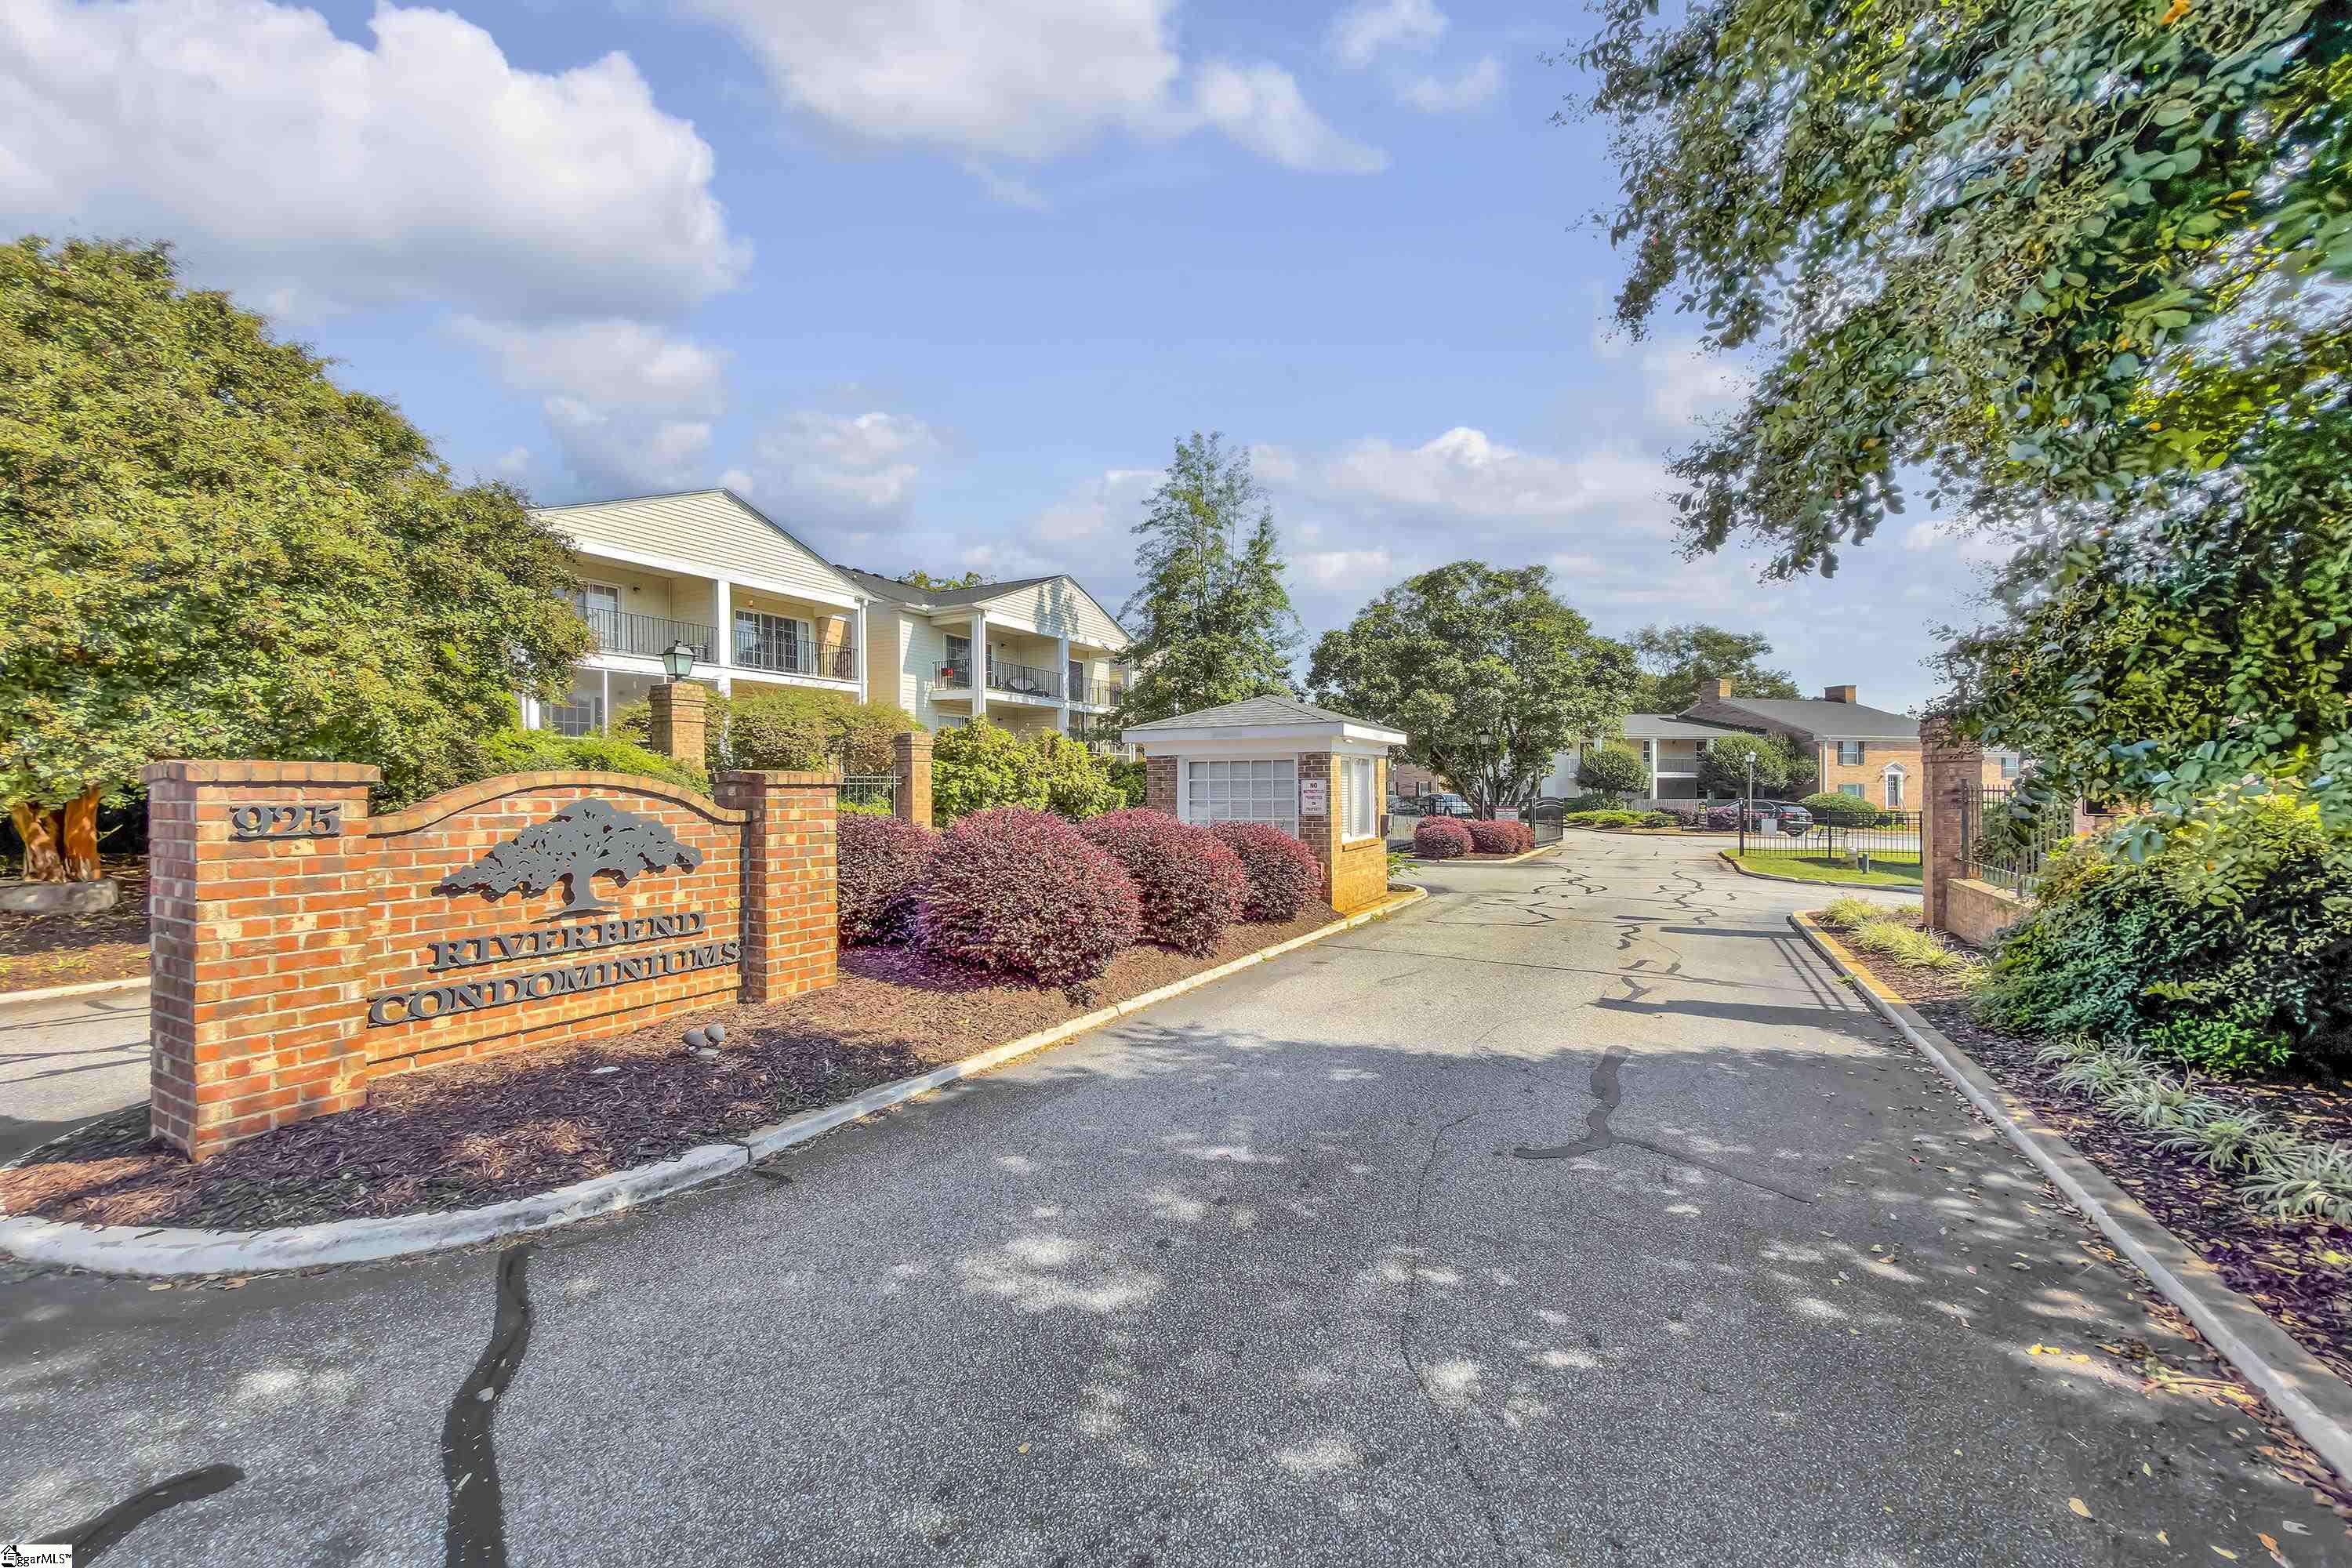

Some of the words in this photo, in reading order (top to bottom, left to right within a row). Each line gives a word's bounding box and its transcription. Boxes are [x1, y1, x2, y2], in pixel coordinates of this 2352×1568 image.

[235, 803, 340, 837] 925
[430, 912, 706, 970] RIVERBEND
[369, 941, 742, 1025] CONDOMINIUMS
